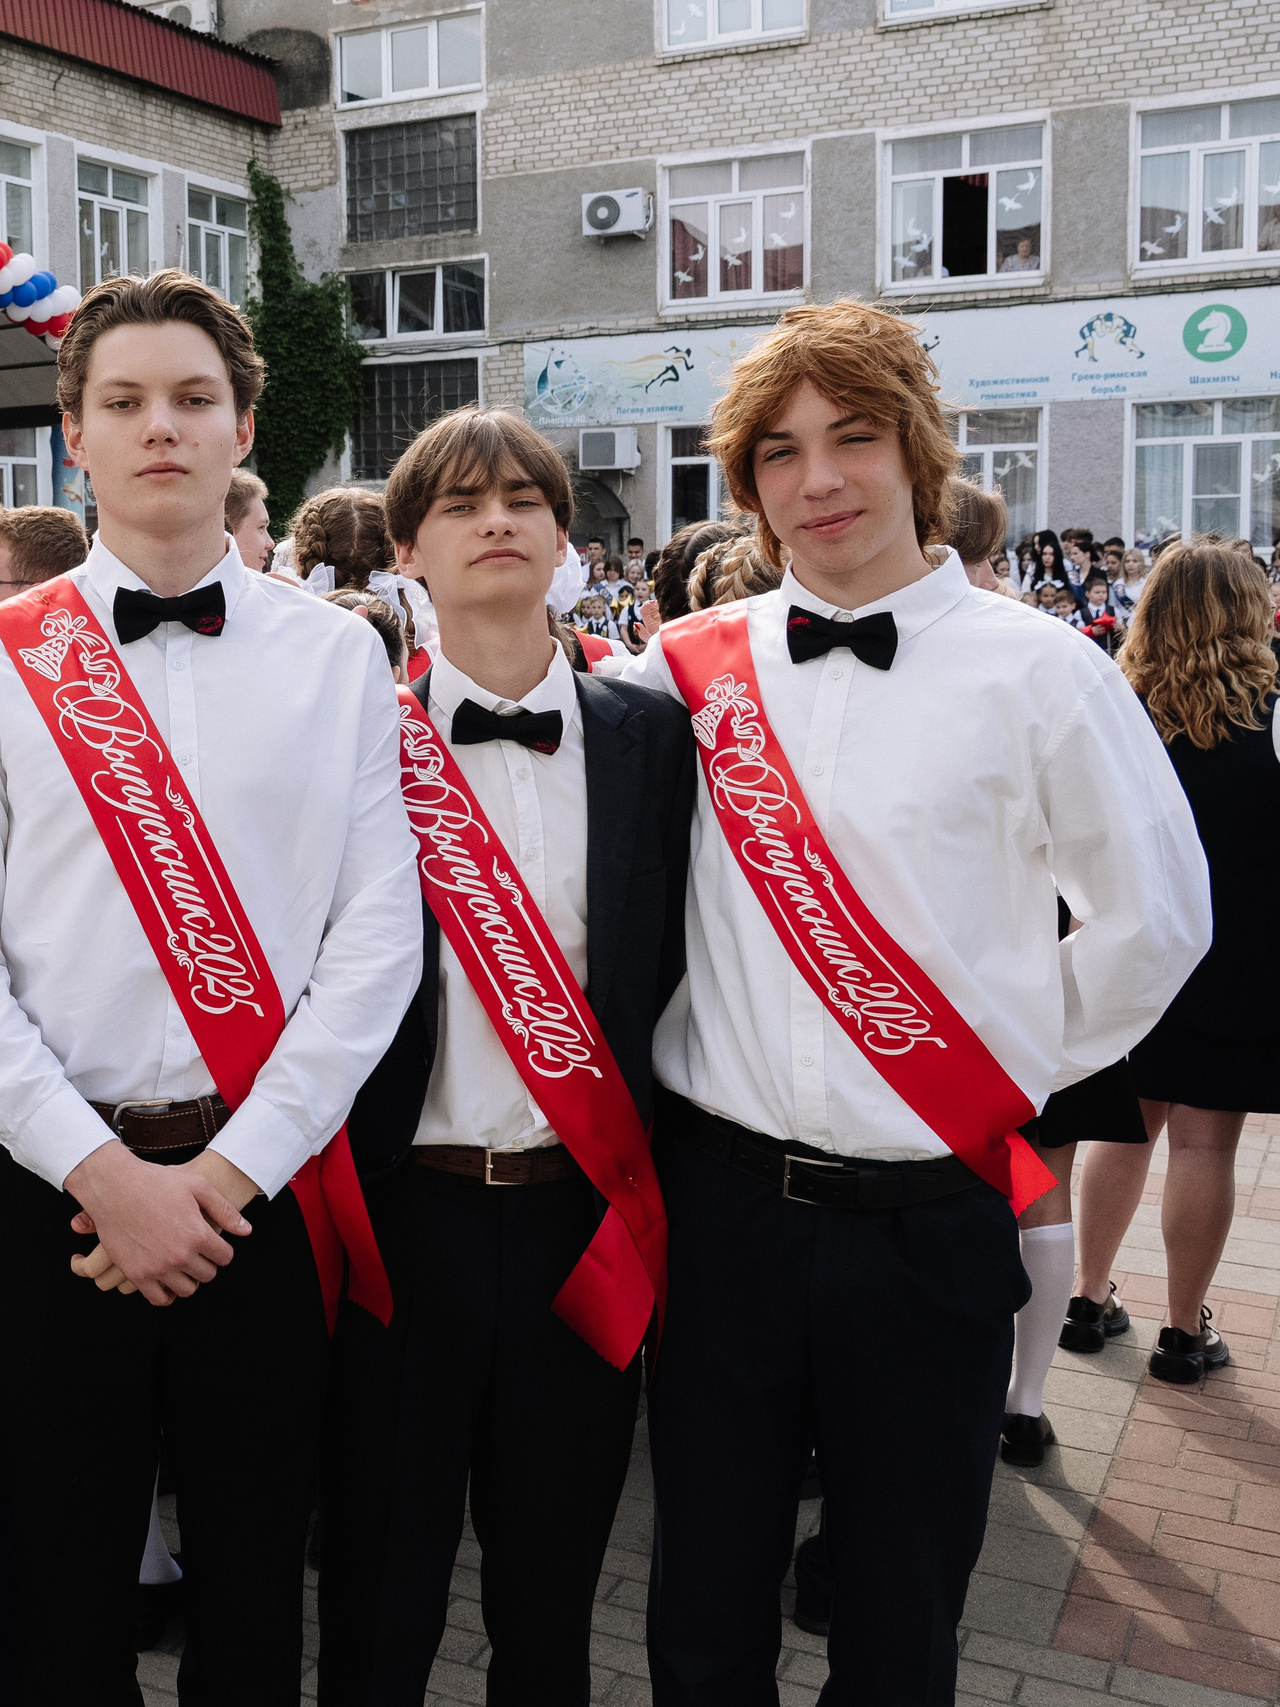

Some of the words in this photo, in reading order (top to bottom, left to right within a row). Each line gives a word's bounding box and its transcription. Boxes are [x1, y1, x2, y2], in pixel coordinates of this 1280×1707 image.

[968, 376, 1050, 388] Художественная
[1071, 371, 1148, 382] Греко-римская
[1189, 375, 1240, 384] Шахматы
[1091, 384, 1127, 395] борьба
[53, 680, 215, 929] Выпускник
[179, 927, 264, 1018] 2025
[709, 746, 872, 981] Выпускник
[836, 981, 948, 1056] 2025
[401, 767, 547, 998] Выпускник
[512, 997, 603, 1079] 2025
